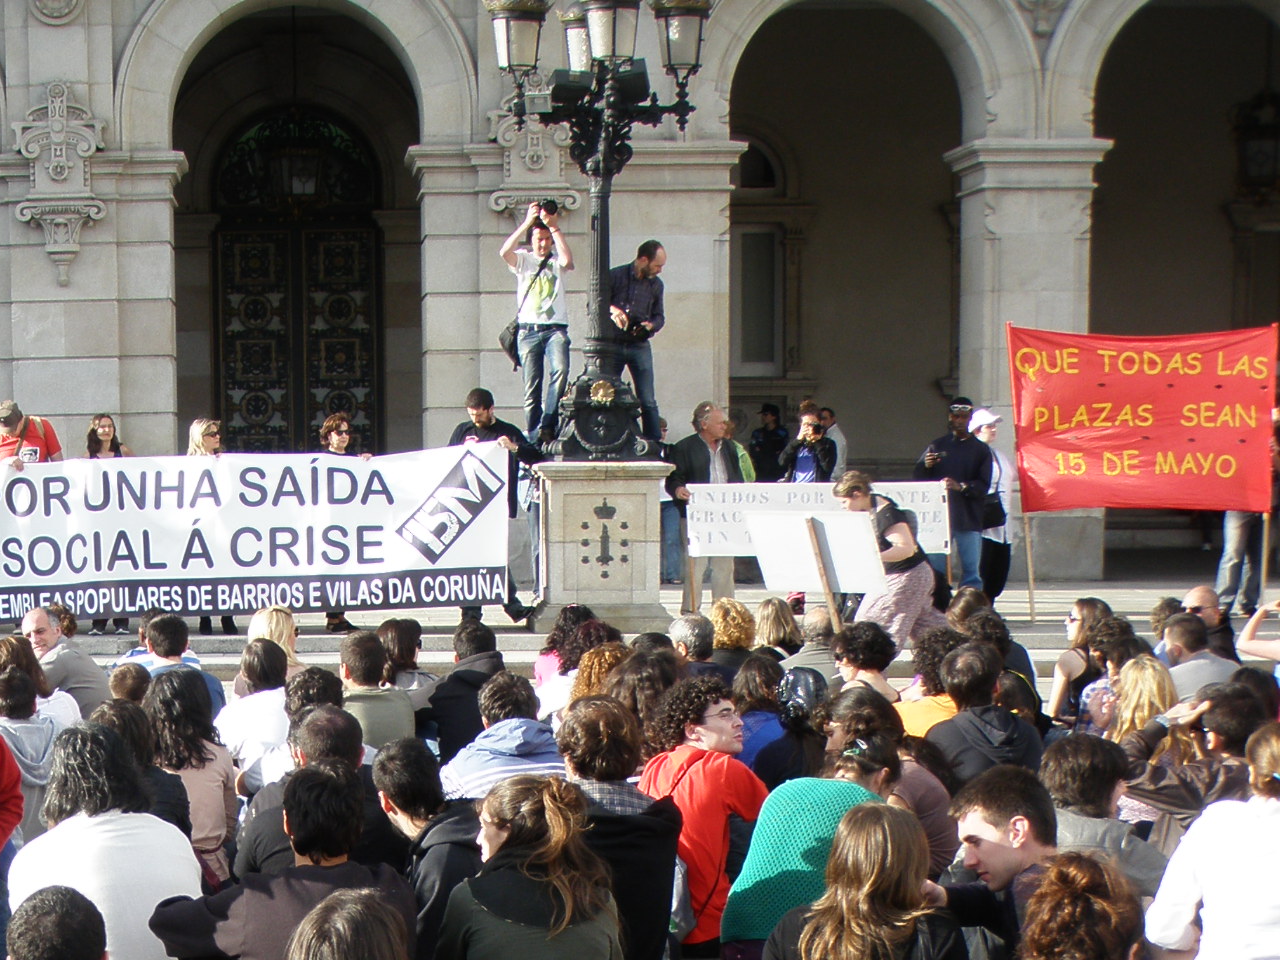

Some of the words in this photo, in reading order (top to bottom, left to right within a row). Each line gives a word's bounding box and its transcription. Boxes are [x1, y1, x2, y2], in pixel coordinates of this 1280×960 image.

[1015, 347, 1079, 381] QUE
[1097, 350, 1202, 375] TODAS
[1216, 351, 1268, 379] LAS
[1034, 402, 1153, 431] PLAZAS
[1180, 402, 1257, 428] SEAN
[1055, 452, 1086, 475] 15
[1103, 450, 1141, 476] DE
[1154, 451, 1237, 478] MAYO
[83, 468, 222, 512] UNHA
[238, 457, 395, 508] SAÍDA
[787, 491, 825, 504] POR
[2, 528, 168, 578] SOCIAL
[181, 518, 214, 570] Á
[230, 525, 385, 567] CRISE
[76, 586, 183, 615] POPULARES
[187, 585, 213, 611] DE
[218, 581, 304, 610] BARRIOS
[310, 581, 321, 606] E
[326, 578, 384, 608] VILAS
[389, 576, 416, 604] DA
[420, 569, 505, 601] CORUÑA
